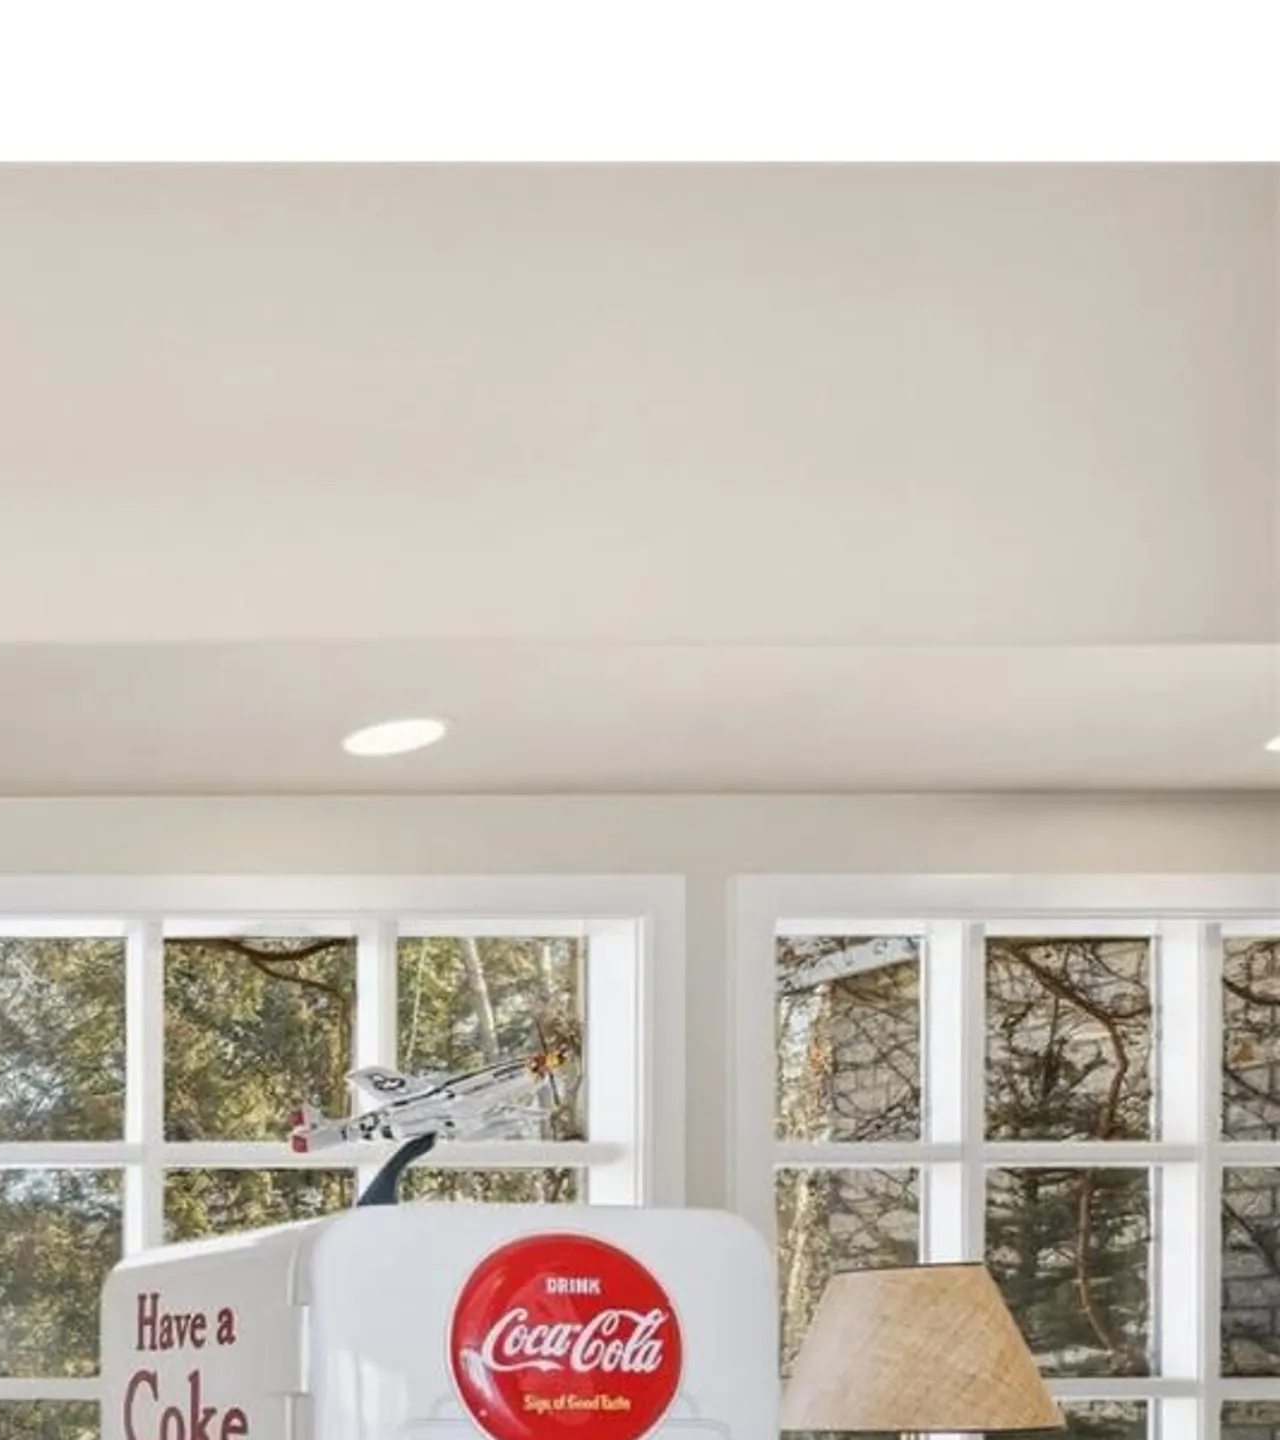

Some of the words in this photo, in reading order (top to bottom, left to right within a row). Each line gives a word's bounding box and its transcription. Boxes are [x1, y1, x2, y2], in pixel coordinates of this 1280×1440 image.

[545, 1277, 601, 1295] DRINK
[136, 1292, 206, 1350] Have
[216, 1307, 236, 1345] a
[482, 1307, 669, 1373] Coca-Cola
